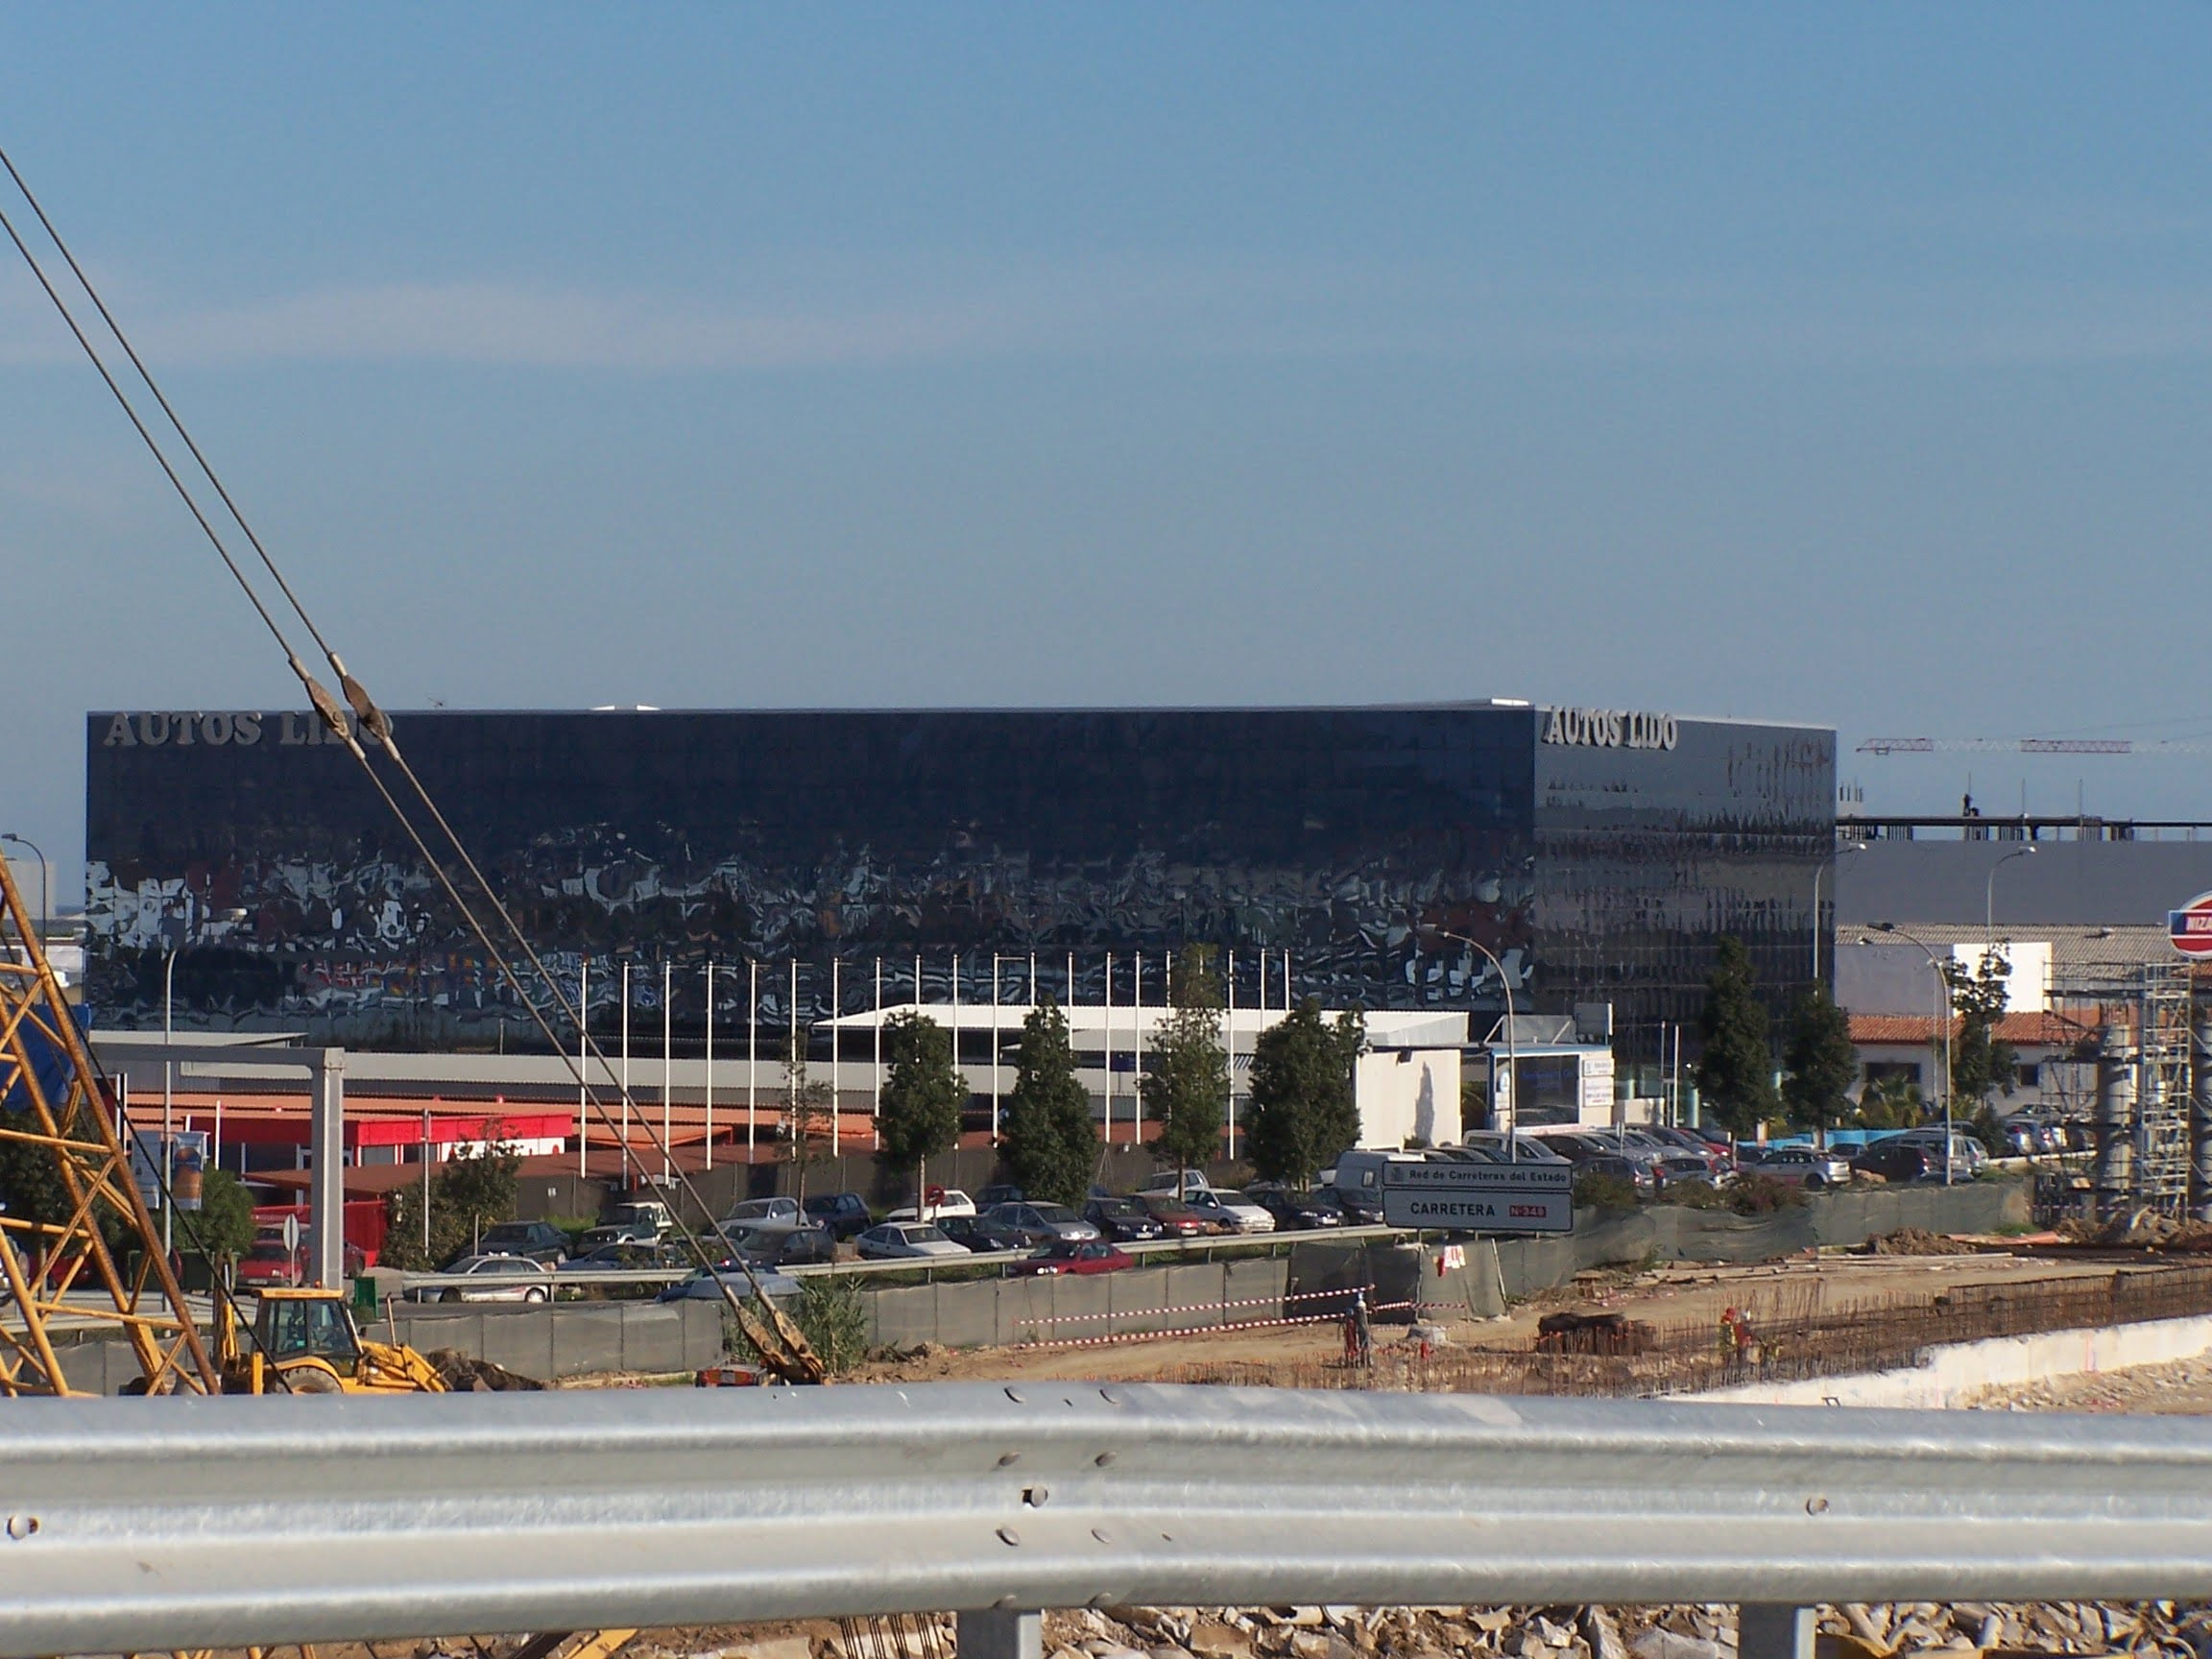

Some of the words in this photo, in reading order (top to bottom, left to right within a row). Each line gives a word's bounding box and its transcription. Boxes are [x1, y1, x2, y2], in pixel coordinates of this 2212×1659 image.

[104, 711, 262, 746] AUTOS
[1543, 707, 1622, 747] AUTOS
[1627, 710, 1678, 751] LIDO
[1409, 1169, 1429, 1180] Red
[1432, 1170, 1445, 1180] de
[1449, 1170, 1506, 1181] Carreteras
[1509, 1171, 1527, 1182] del
[1530, 1172, 1567, 1183] Estado
[1410, 1202, 1495, 1216] CARRETERA
